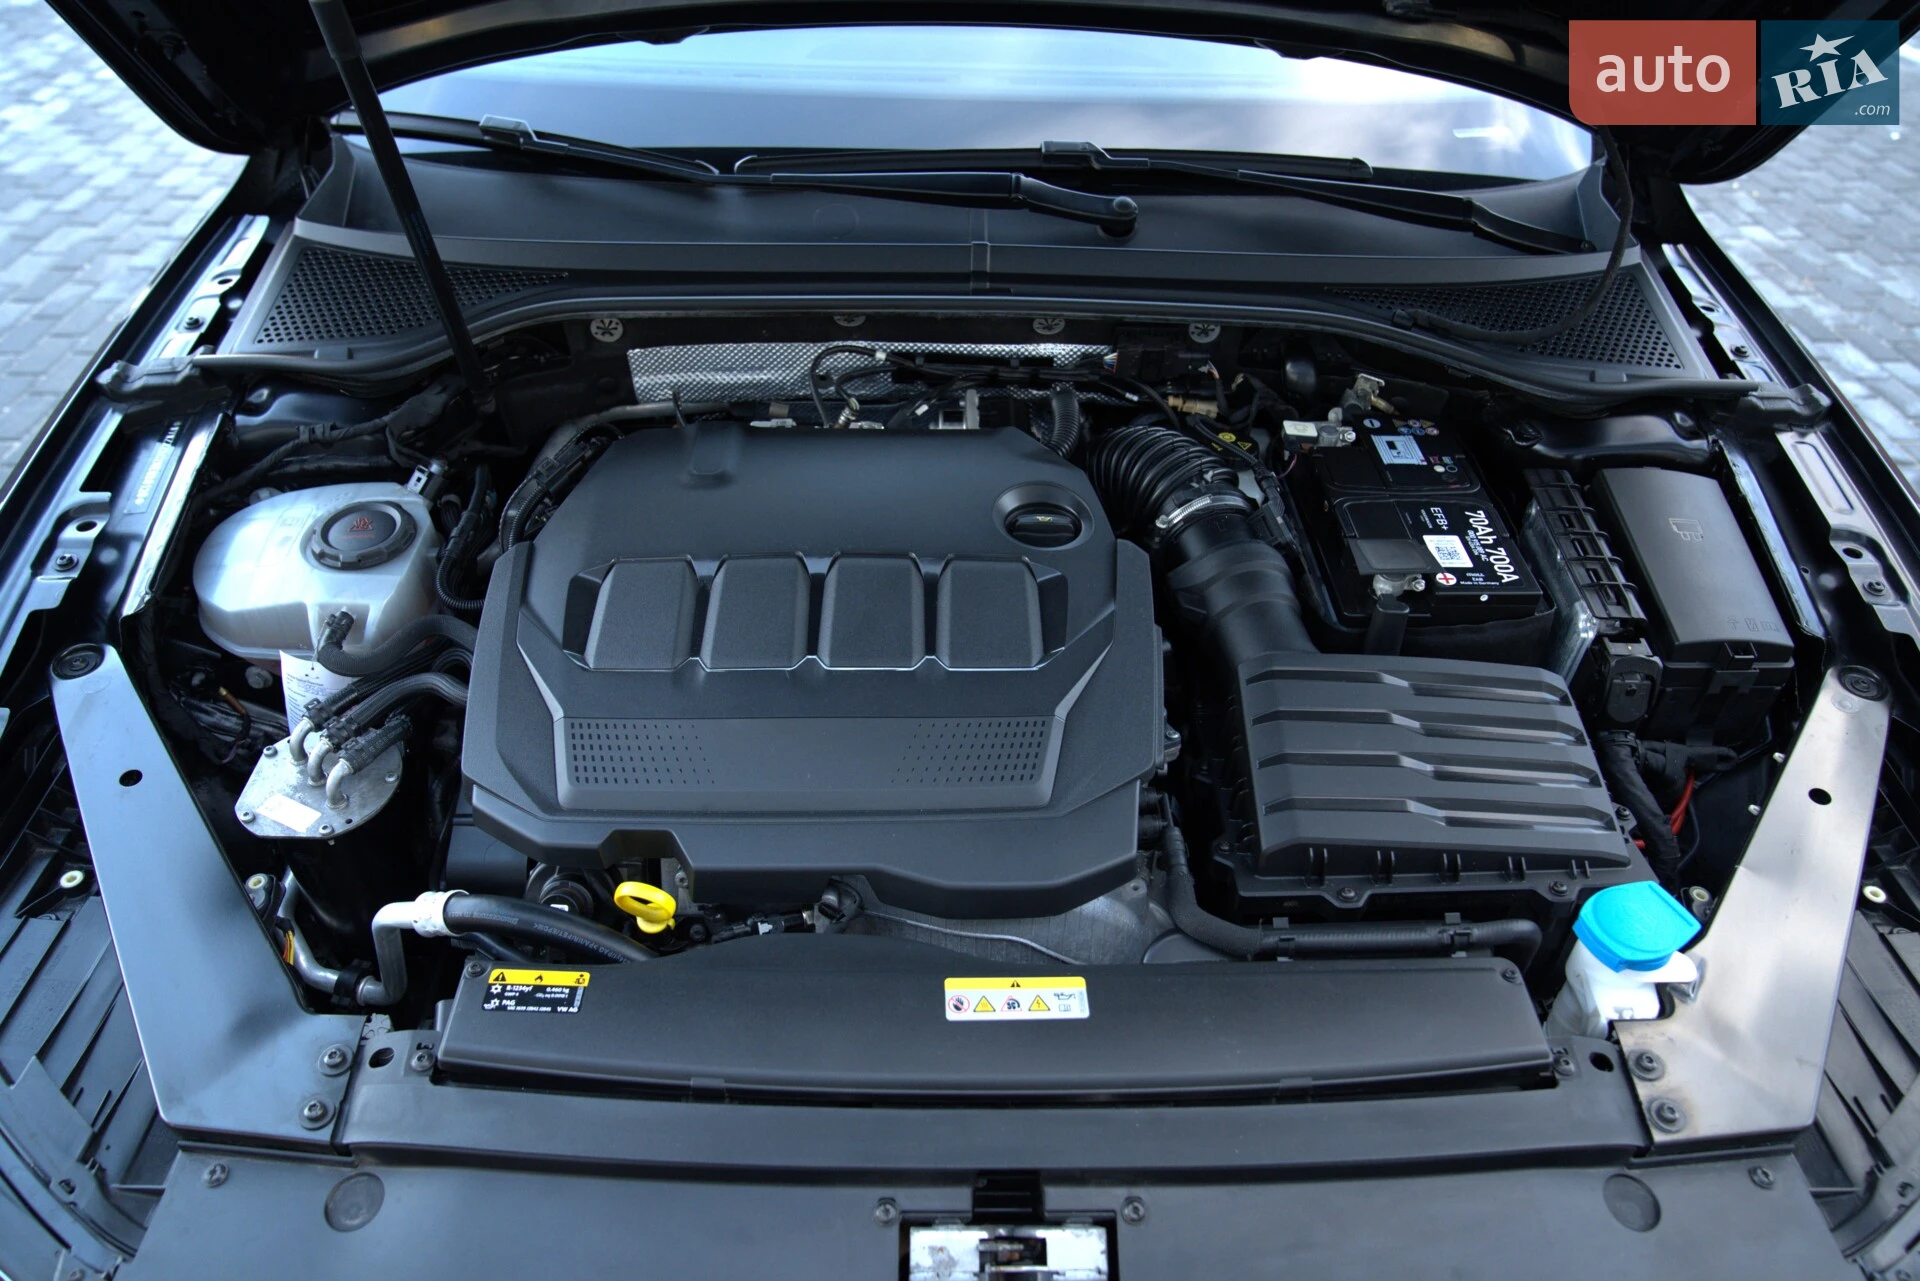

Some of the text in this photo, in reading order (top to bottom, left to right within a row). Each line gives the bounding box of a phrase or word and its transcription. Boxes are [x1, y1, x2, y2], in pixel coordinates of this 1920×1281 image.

[1430, 507, 1449, 531] EFB+
[1464, 510, 1520, 583] 70Ah 700A
[506, 985, 534, 993] R-1234yf
